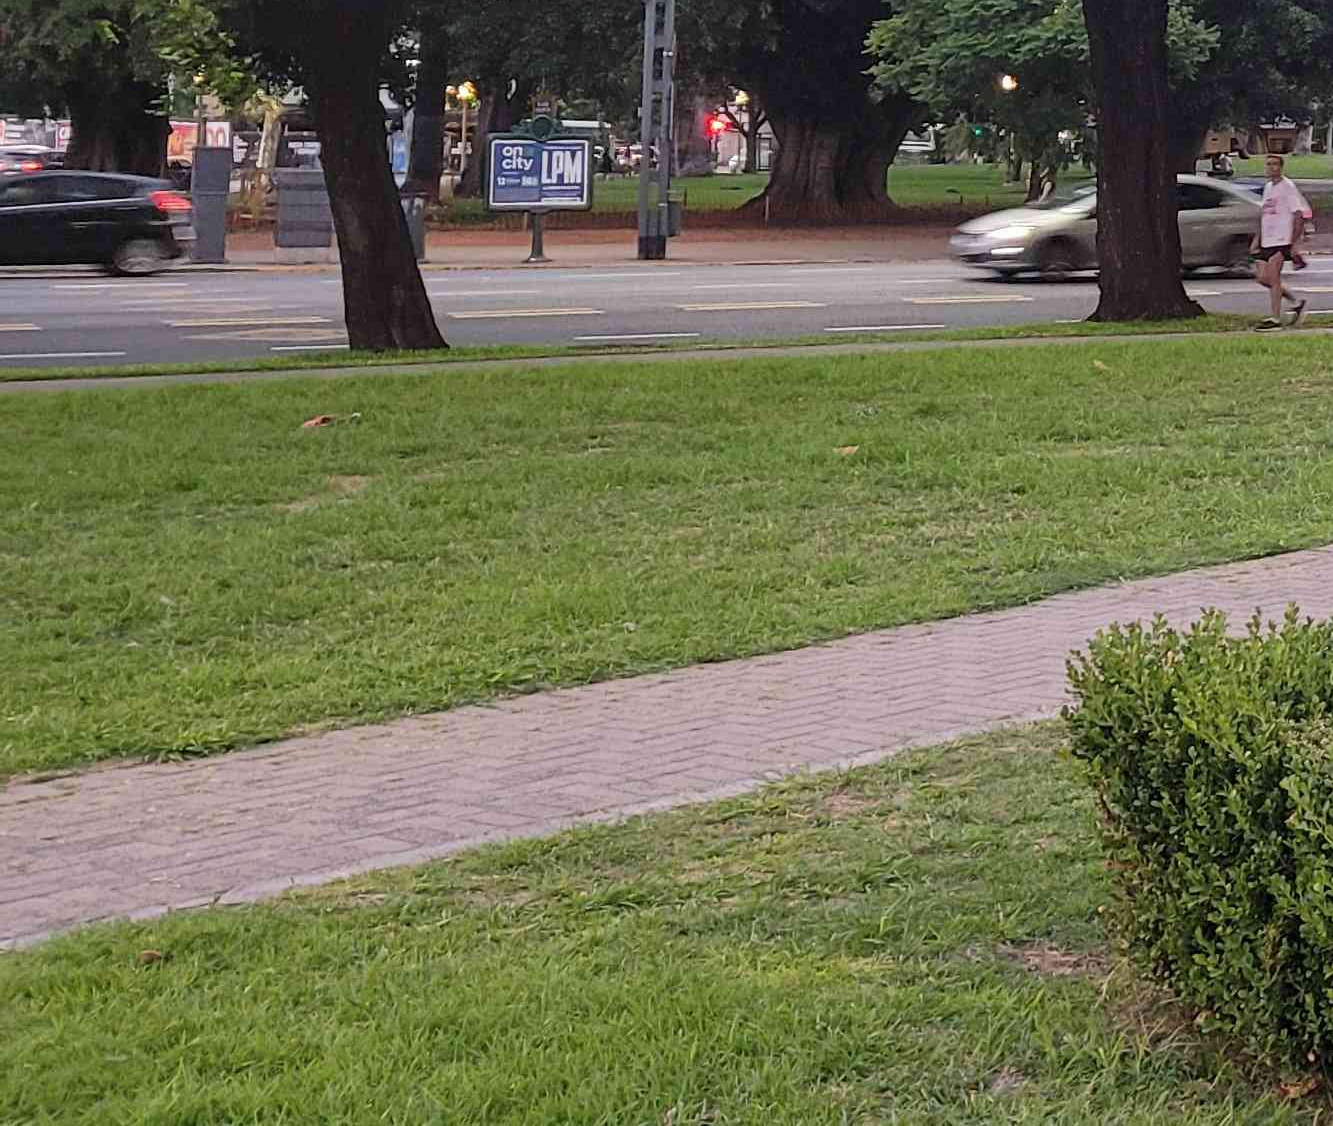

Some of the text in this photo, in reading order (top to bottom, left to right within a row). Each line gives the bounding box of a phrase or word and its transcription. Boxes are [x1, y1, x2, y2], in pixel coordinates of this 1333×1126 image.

[502, 146, 523, 157] on
[501, 156, 534, 170] city
[541, 151, 583, 184] LPM
